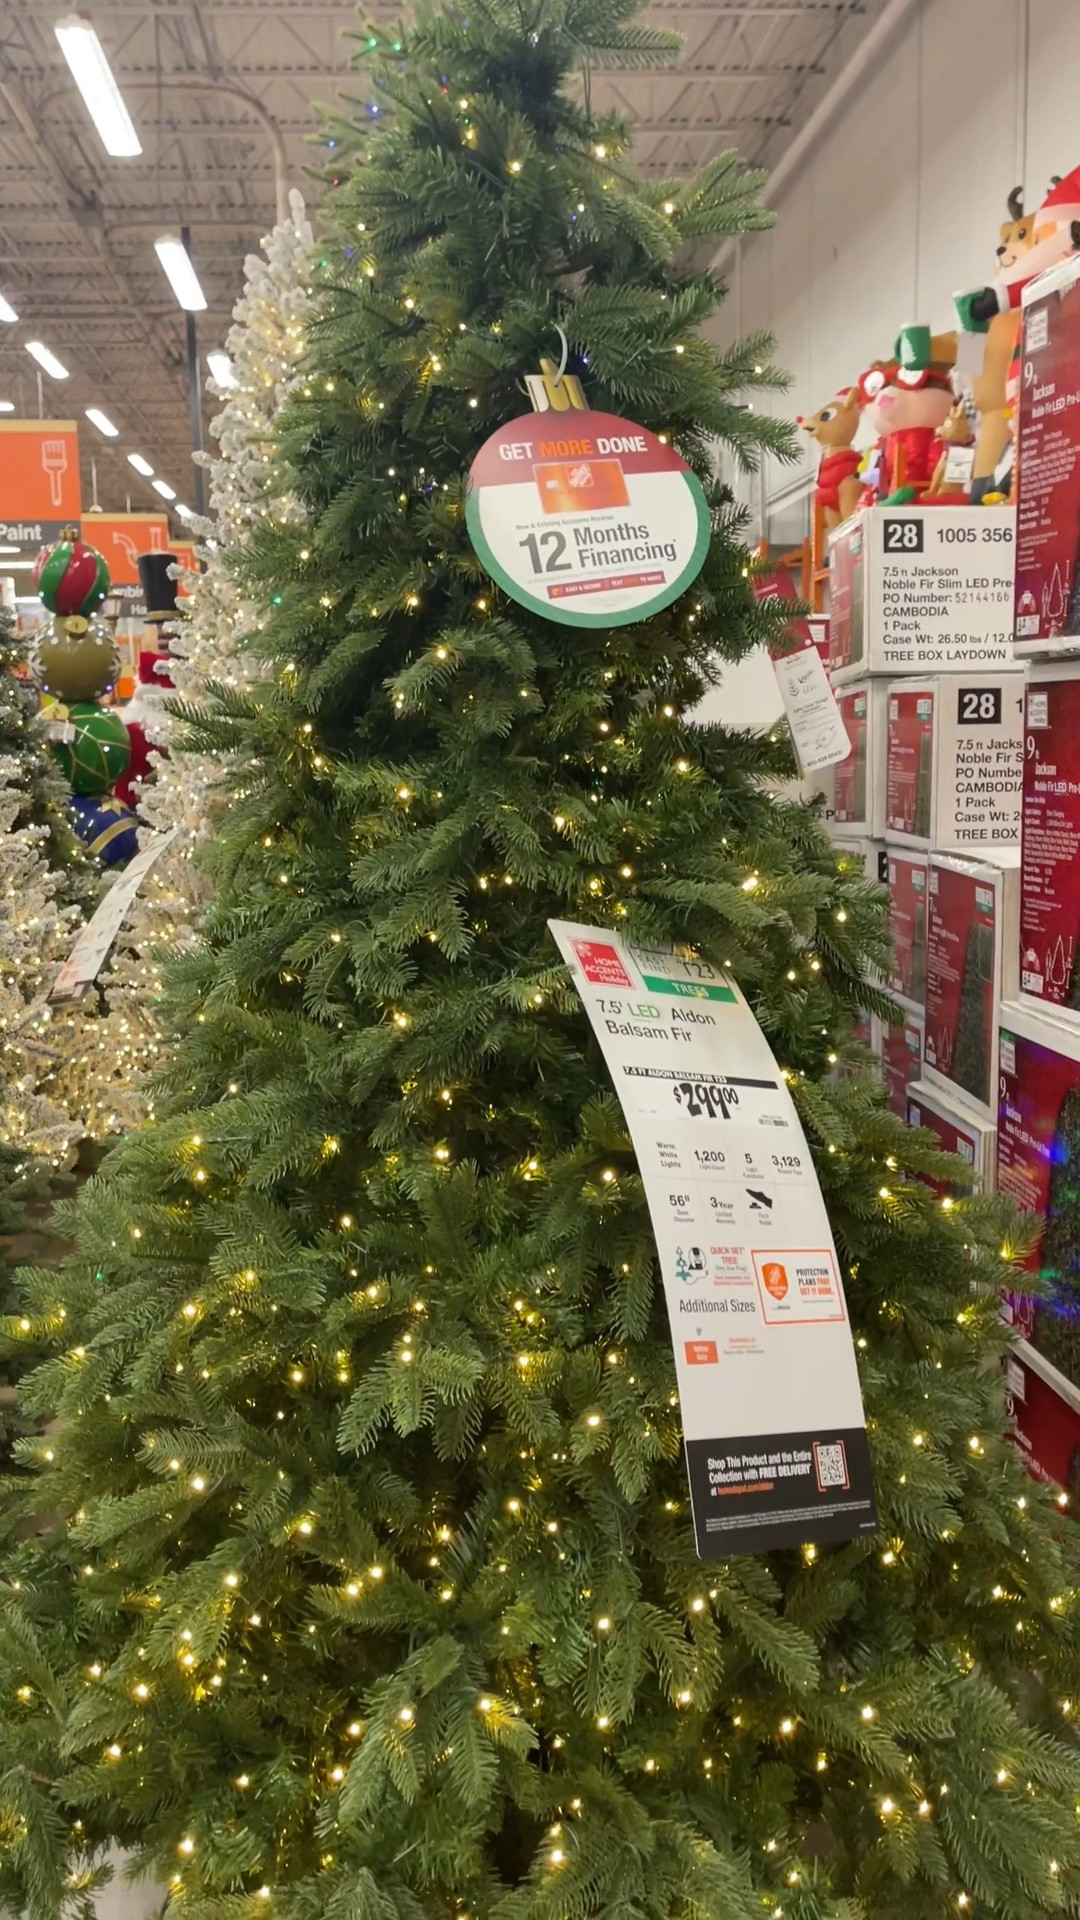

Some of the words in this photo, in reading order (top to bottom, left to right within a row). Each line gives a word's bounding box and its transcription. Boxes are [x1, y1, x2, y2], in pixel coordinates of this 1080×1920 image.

[1024, 361, 1033, 388] 9
[1053, 397, 1066, 412] LED
[499, 442, 533, 460] GET
[538, 439, 594, 458] MORE
[597, 436, 648, 454] DONE
[573, 523, 649, 546] Months
[888, 524, 918, 548] 28
[937, 528, 977, 543] 1005
[982, 528, 1013, 542] 356
[519, 531, 572, 574] 12
[883, 567, 899, 577] 7.5
[901, 569, 908, 577] ft
[911, 567, 959, 577] Jackson
[883, 580, 916, 590] Noble
[920, 579, 935, 589] Fir
[938, 578, 963, 589] Slim
[966, 579, 989, 588] LED
[883, 593, 900, 603] PO
[904, 592, 952, 603] Number:
[883, 606, 949, 617] CAMBODIA
[884, 622, 889, 630] 1
[893, 621, 921, 630] Pack
[883, 634, 912, 645] Case
[915, 634, 933, 644] Wt:
[938, 633, 967, 644] 26.50
[883, 651, 914, 661] TREE
[918, 650, 943, 660] BOX
[947, 649, 1006, 660] LAYDOWN
[962, 693, 995, 719] 28
[957, 740, 974, 750] 7.5
[976, 741, 983, 750] ft
[1026, 736, 1036, 759] 9
[956, 753, 992, 764] Noble
[996, 752, 1012, 763] Fir
[956, 768, 974, 778] PO
[1054, 782, 1067, 792] LED
[956, 798, 961, 807] 1
[966, 797, 996, 807] Pack
[955, 812, 985, 822] Case
[989, 811, 1009, 821] Wt:
[955, 829, 988, 839] TREE
[991, 828, 1019, 839] BOX
[594, 957, 621, 967] HOME
[585, 965, 626, 977] ACCENTS
[671, 982, 709, 997] TREES
[596, 999, 623, 1015] 7.5'
[627, 1003, 661, 1019] LED
[671, 1008, 716, 1026] Aldon
[605, 1020, 669, 1040] Balsam
[671, 1027, 692, 1042] Fir
[648, 1068, 673, 1078] ALDON
[674, 1071, 703, 1081] BALSAM
[1000, 1075, 1007, 1098] 9
[694, 1150, 725, 1164] 1,200
[745, 1153, 753, 1164] 5
[771, 1155, 801, 1169] 3,129
[660, 1160, 681, 1169] Lights
[710, 1197, 718, 1208] 3
[718, 1201, 733, 1209] Year
[710, 1246, 729, 1255] QUICK
[721, 1256, 738, 1265] TREE
[796, 1268, 829, 1276] PROTECTION
[798, 1278, 816, 1286] PLANS
[680, 1299, 728, 1312] Additional
[730, 1299, 756, 1312] Sizes
[707, 1457, 726, 1471] Shop
[726, 1456, 741, 1468] This
[741, 1454, 767, 1466] Product
[768, 1452, 780, 1464] and
[781, 1451, 792, 1462] the
[793, 1450, 811, 1461] Entire
[709, 1470, 742, 1484] Collection
[744, 1468, 758, 1480] with
[759, 1466, 777, 1479] FREE
[778, 1463, 811, 1477] DELIVERY
[711, 1487, 717, 1496] at
